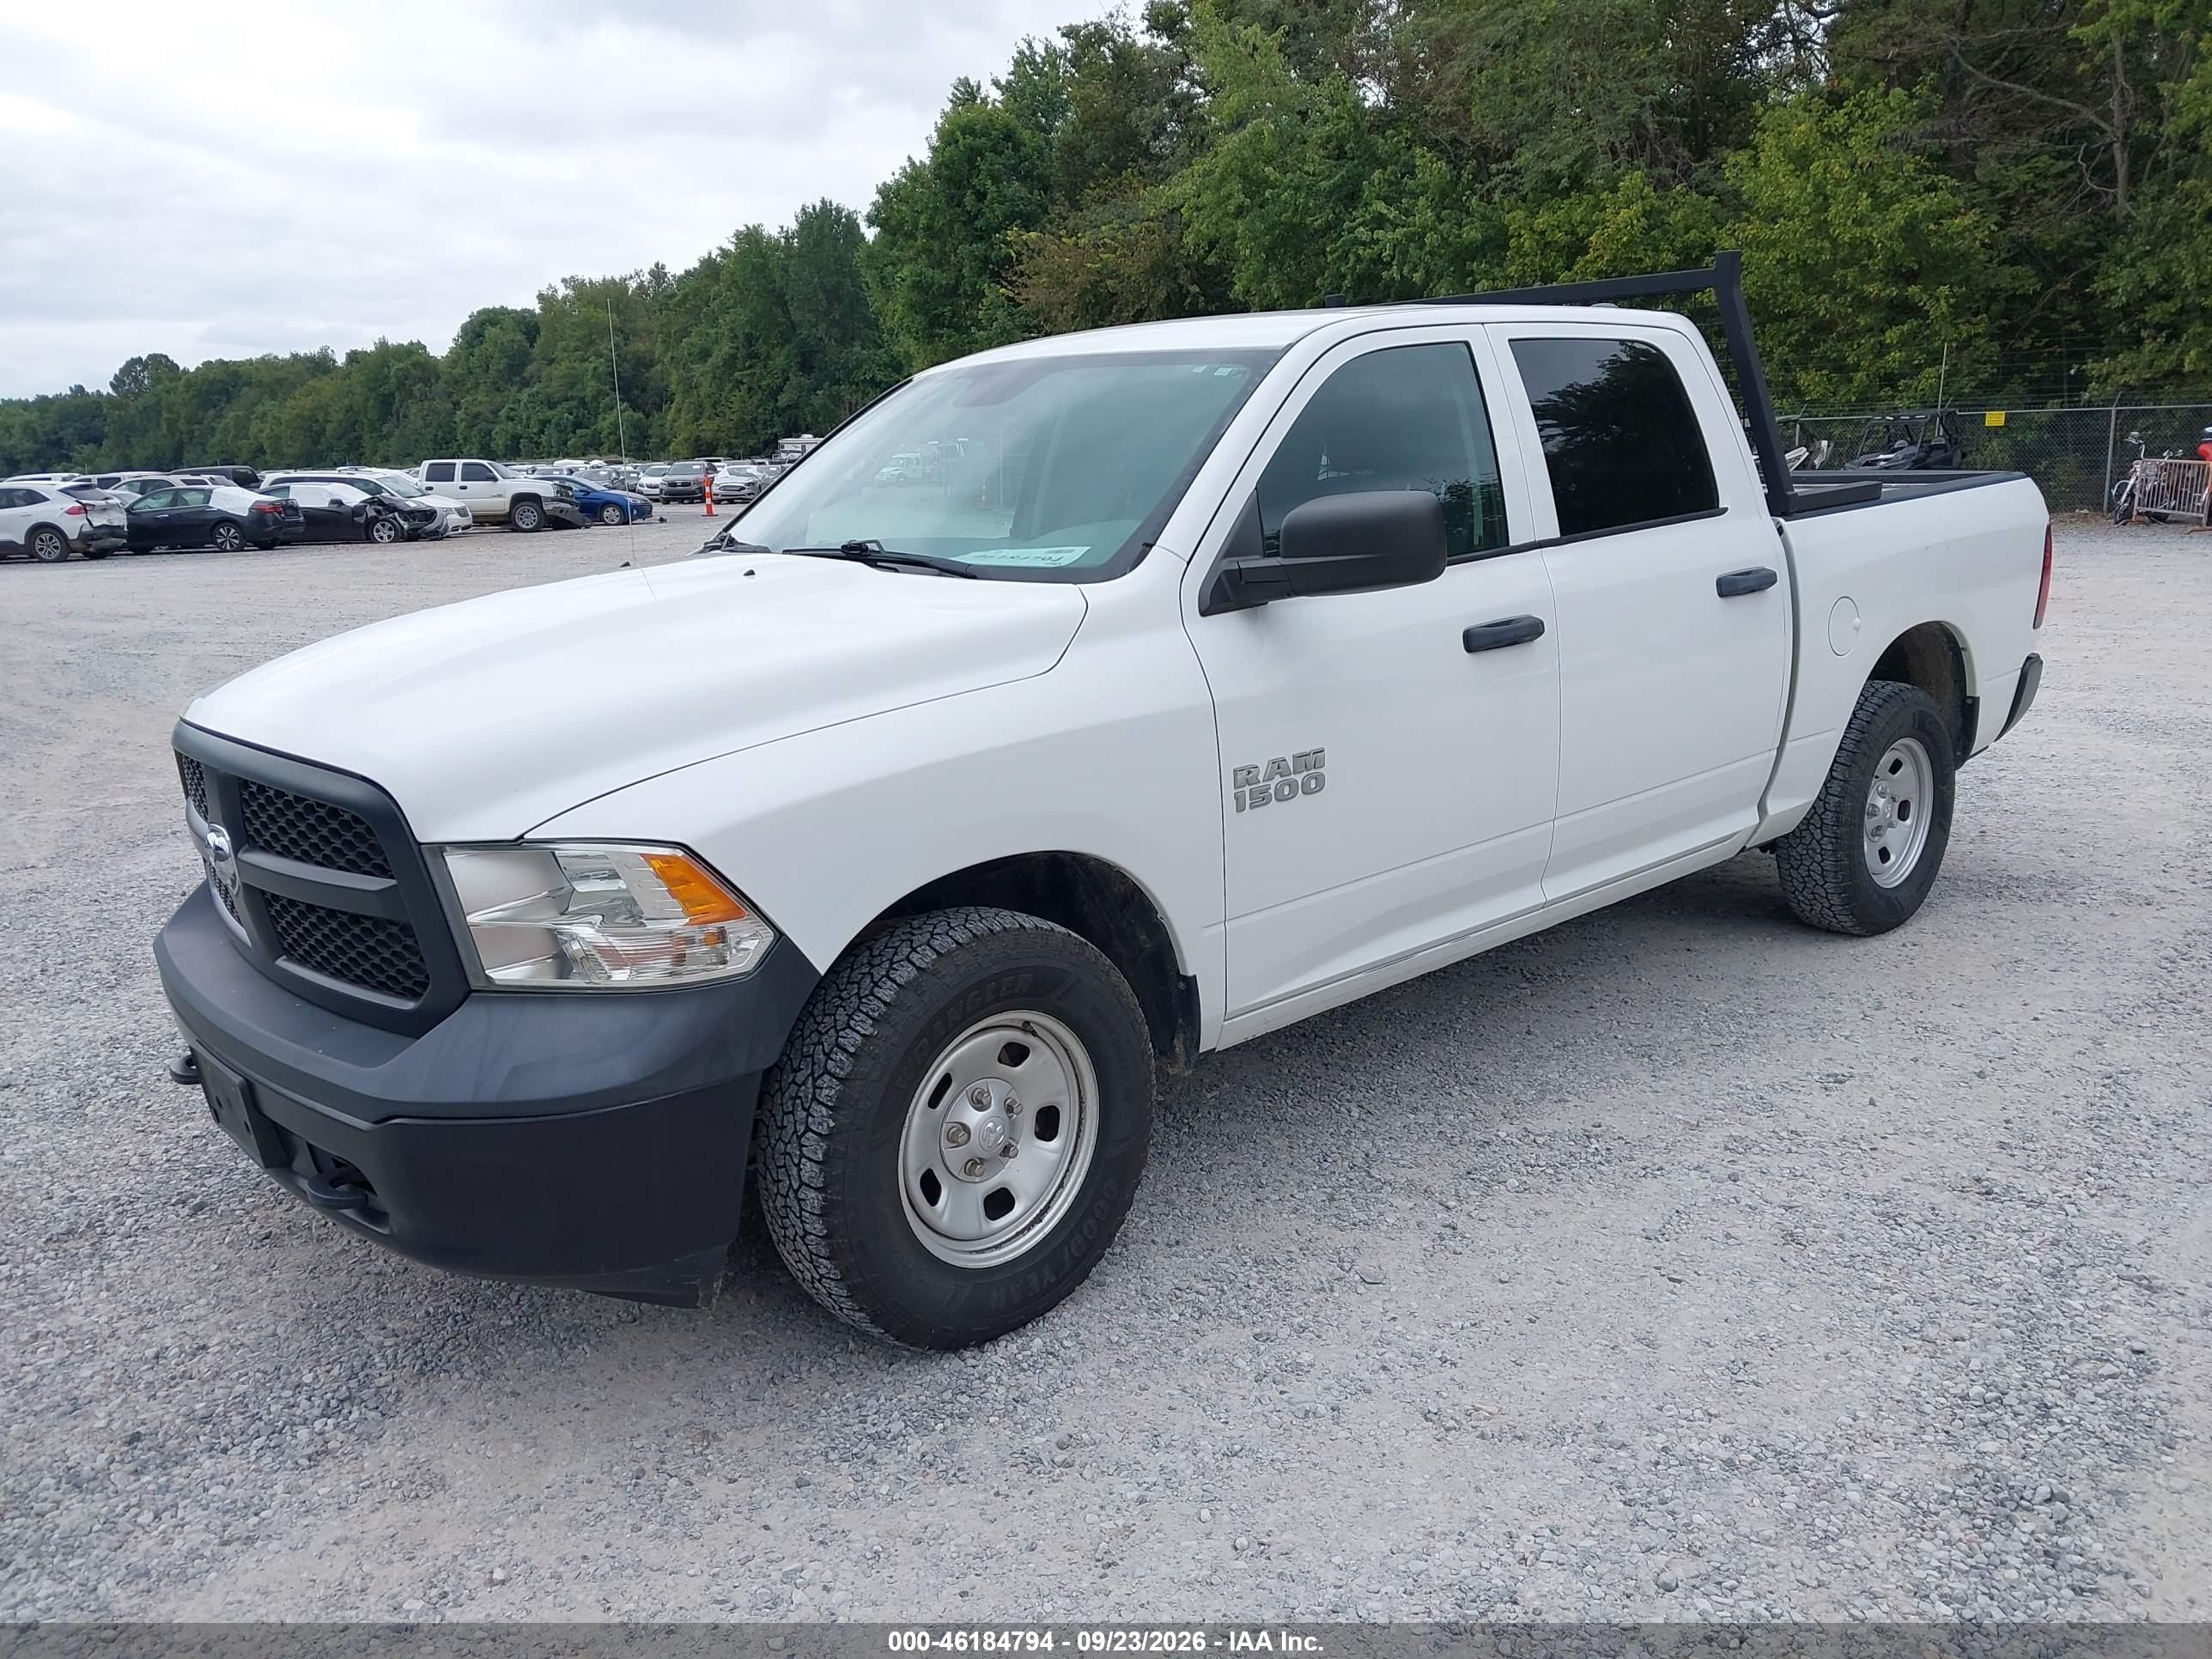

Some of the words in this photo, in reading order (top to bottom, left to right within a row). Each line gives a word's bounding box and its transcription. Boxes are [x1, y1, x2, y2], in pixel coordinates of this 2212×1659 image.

[1233, 747, 1326, 789] RAM
[1234, 771, 1326, 812] 1500
[895, 973, 1034, 1090] WRANGLER
[989, 1177, 1120, 1311] GOODYEAR
